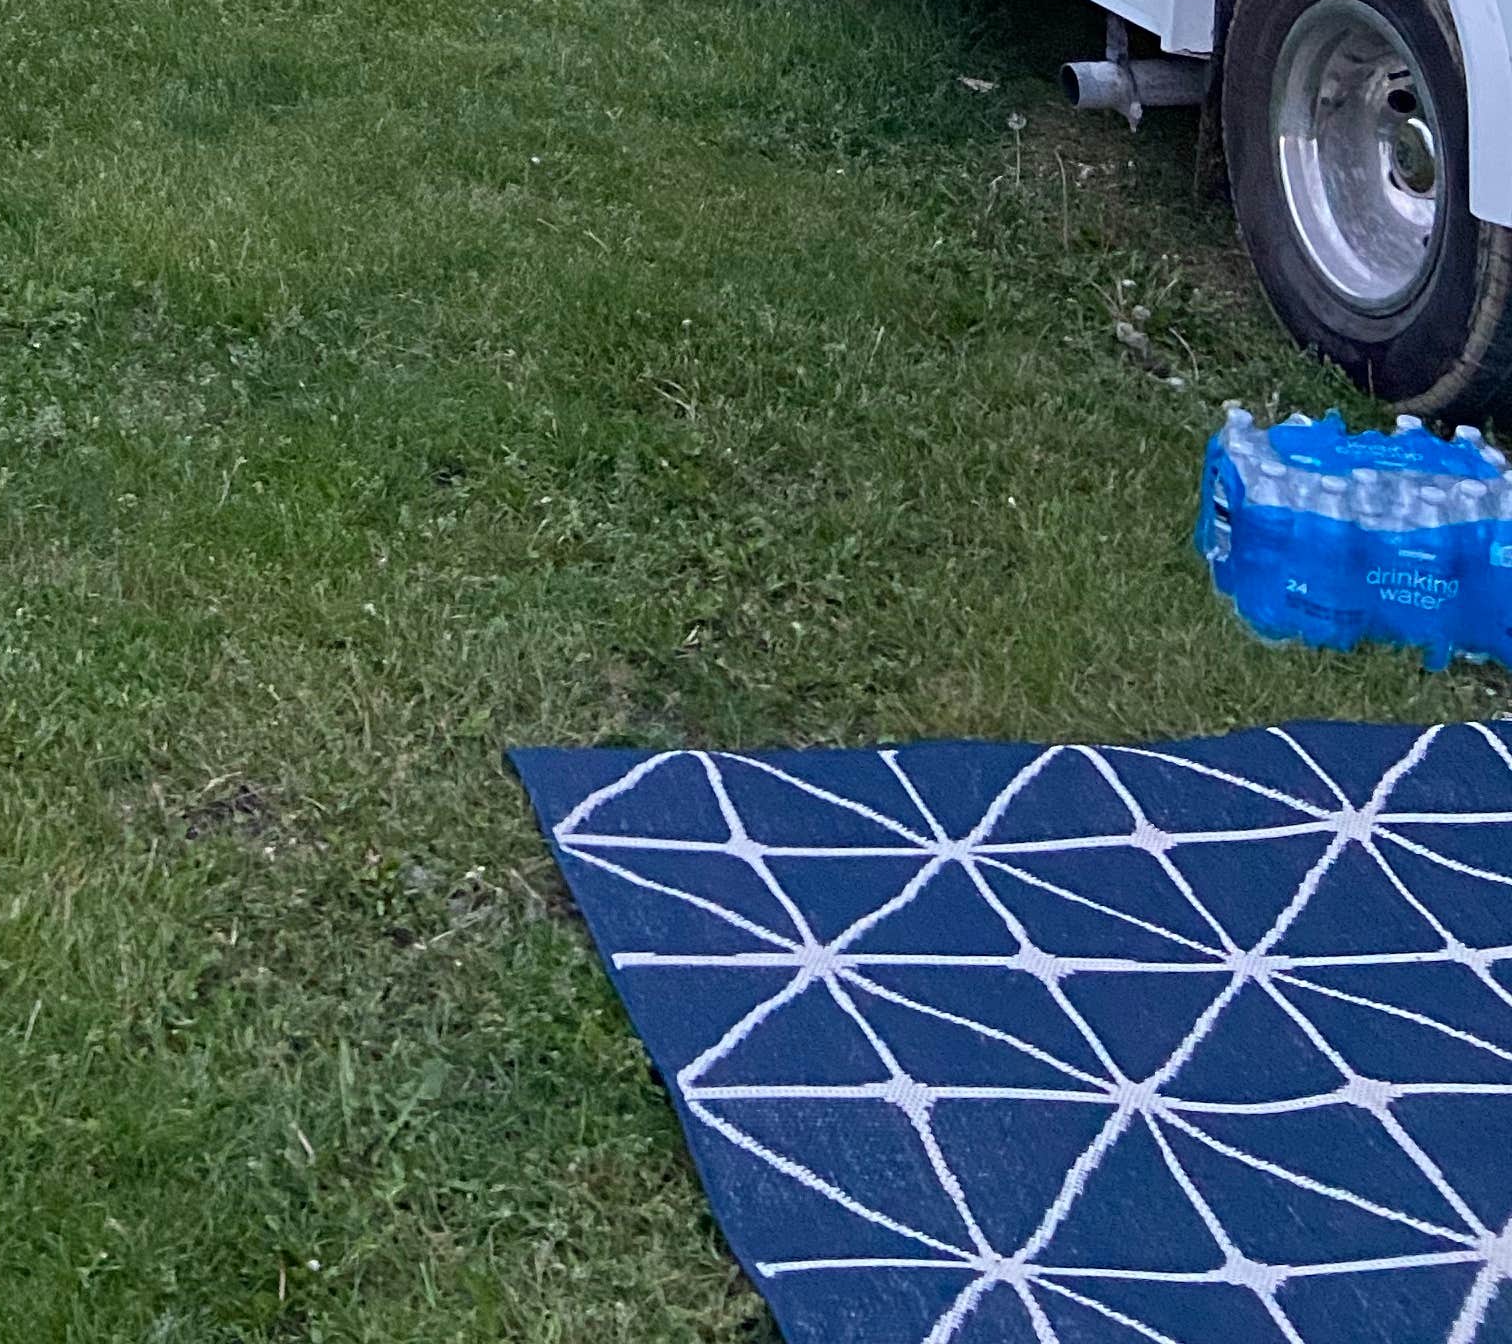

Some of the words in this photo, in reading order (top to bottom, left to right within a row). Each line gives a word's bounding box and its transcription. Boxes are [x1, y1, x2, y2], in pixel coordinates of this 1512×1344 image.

[1286, 578, 1308, 595] 24
[1366, 566, 1460, 599] drinking
[1379, 586, 1446, 610] water
